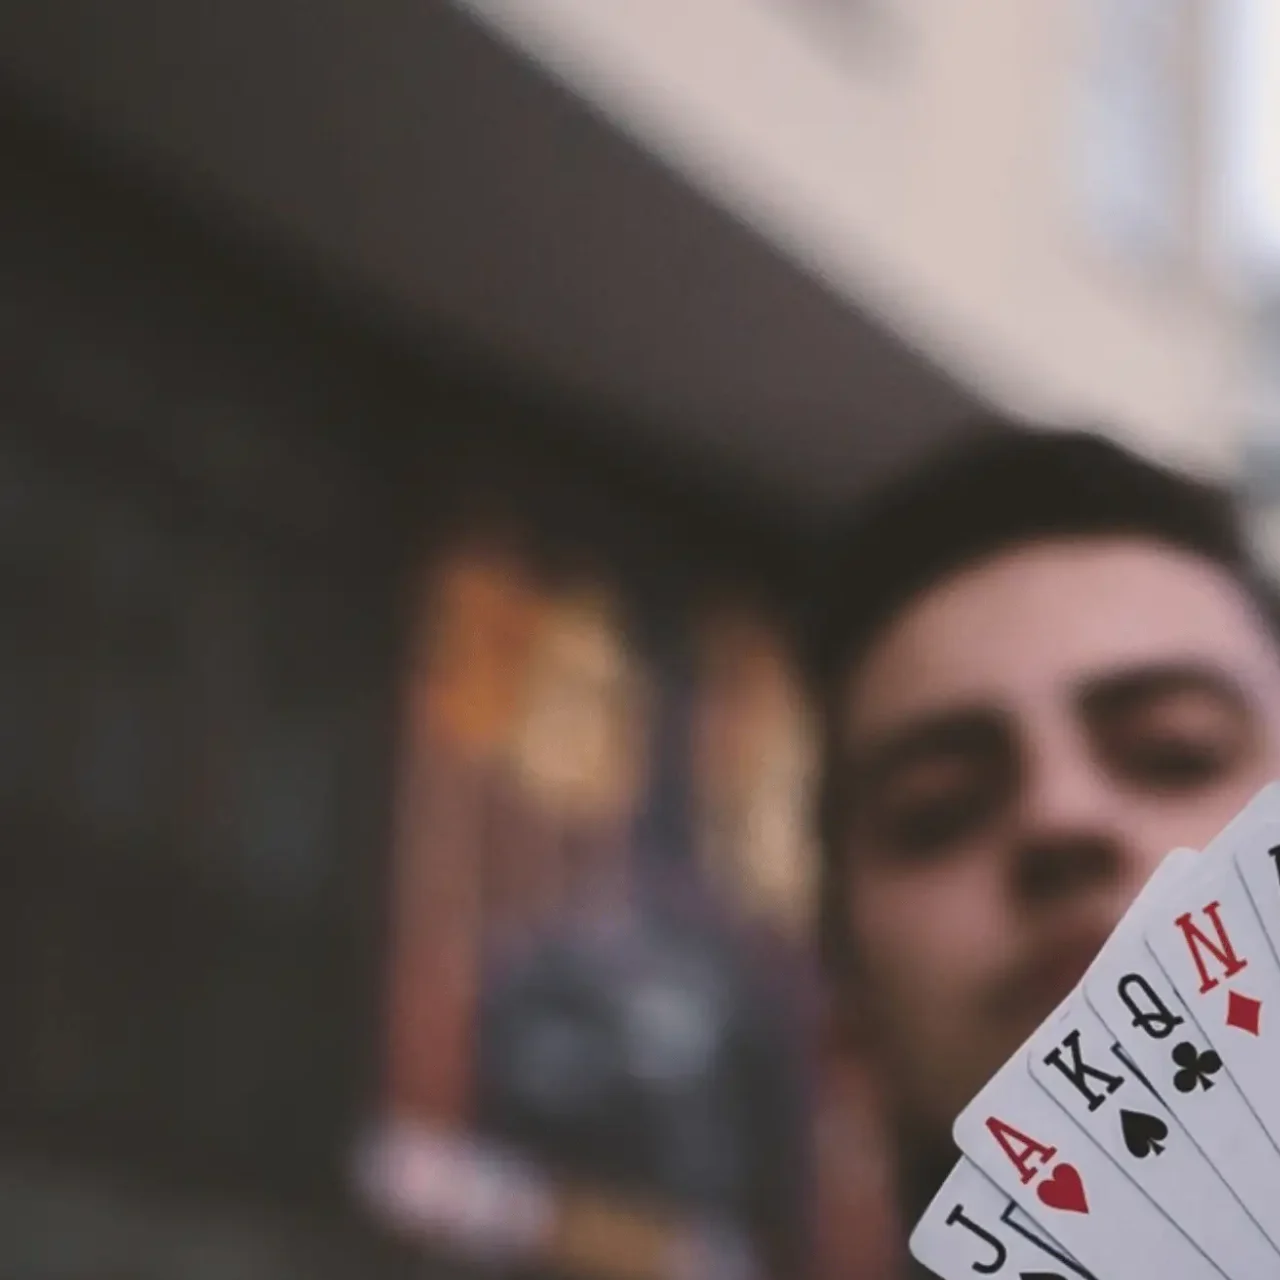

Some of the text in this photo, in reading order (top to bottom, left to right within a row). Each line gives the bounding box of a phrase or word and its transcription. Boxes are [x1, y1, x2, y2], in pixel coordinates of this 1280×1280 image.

[1174, 901, 1248, 994] N
[1117, 973, 1184, 1039] Q
[1043, 1029, 1125, 1112] K
[984, 1116, 1057, 1185] A
[946, 1204, 1007, 1275] J
